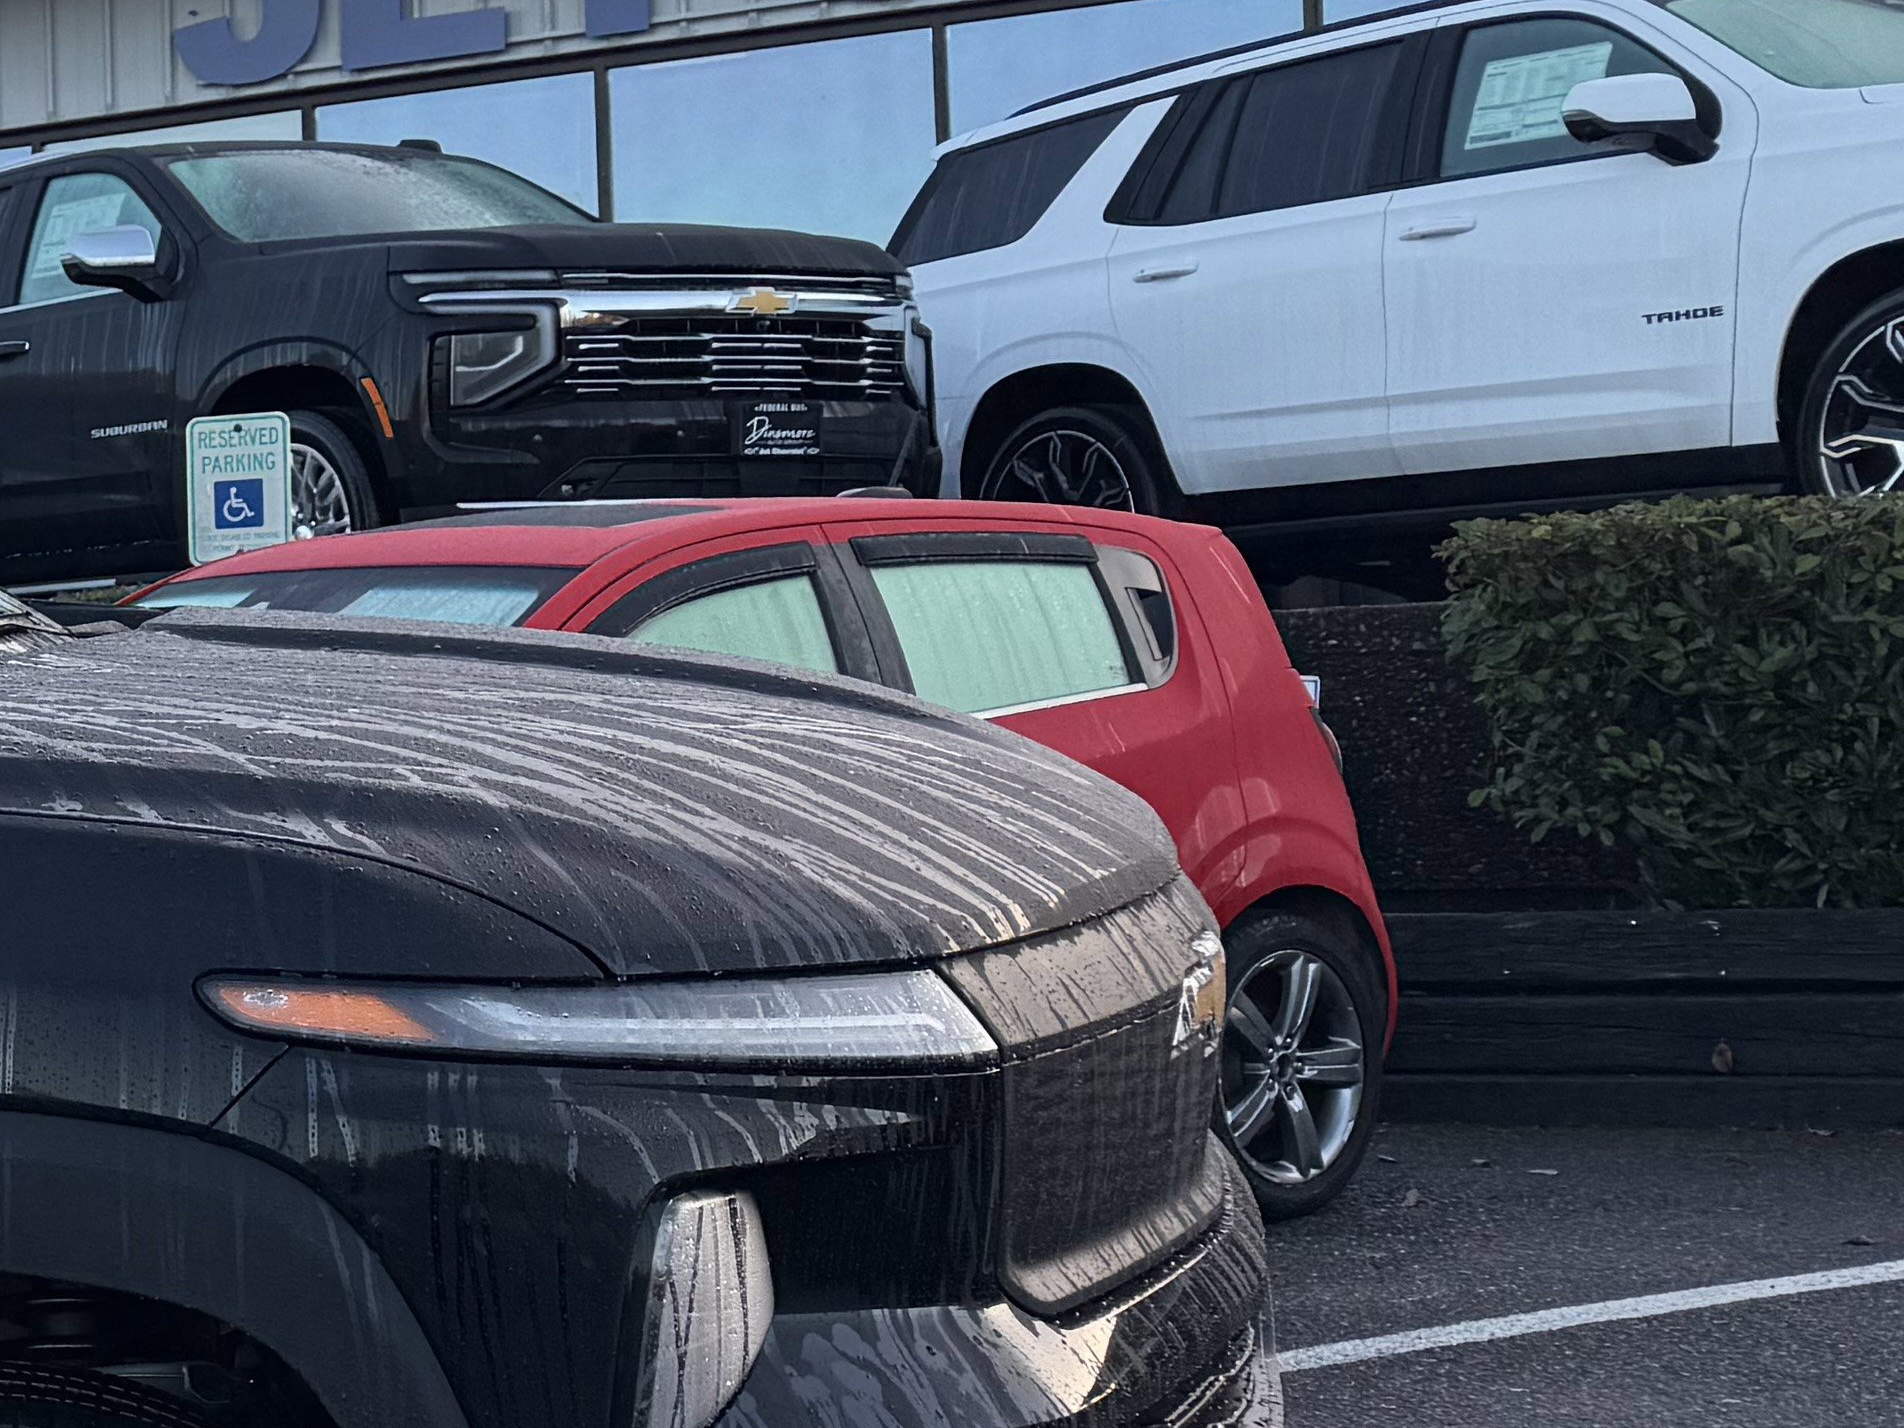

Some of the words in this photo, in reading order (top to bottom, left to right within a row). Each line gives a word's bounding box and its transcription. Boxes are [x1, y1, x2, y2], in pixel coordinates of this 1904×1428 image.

[1641, 305, 1724, 325] TAHOE
[91, 419, 168, 439] SUBURBAN
[198, 426, 279, 450] RESERVED
[744, 415, 816, 445] Dinsmore
[202, 452, 276, 474] PARKING
